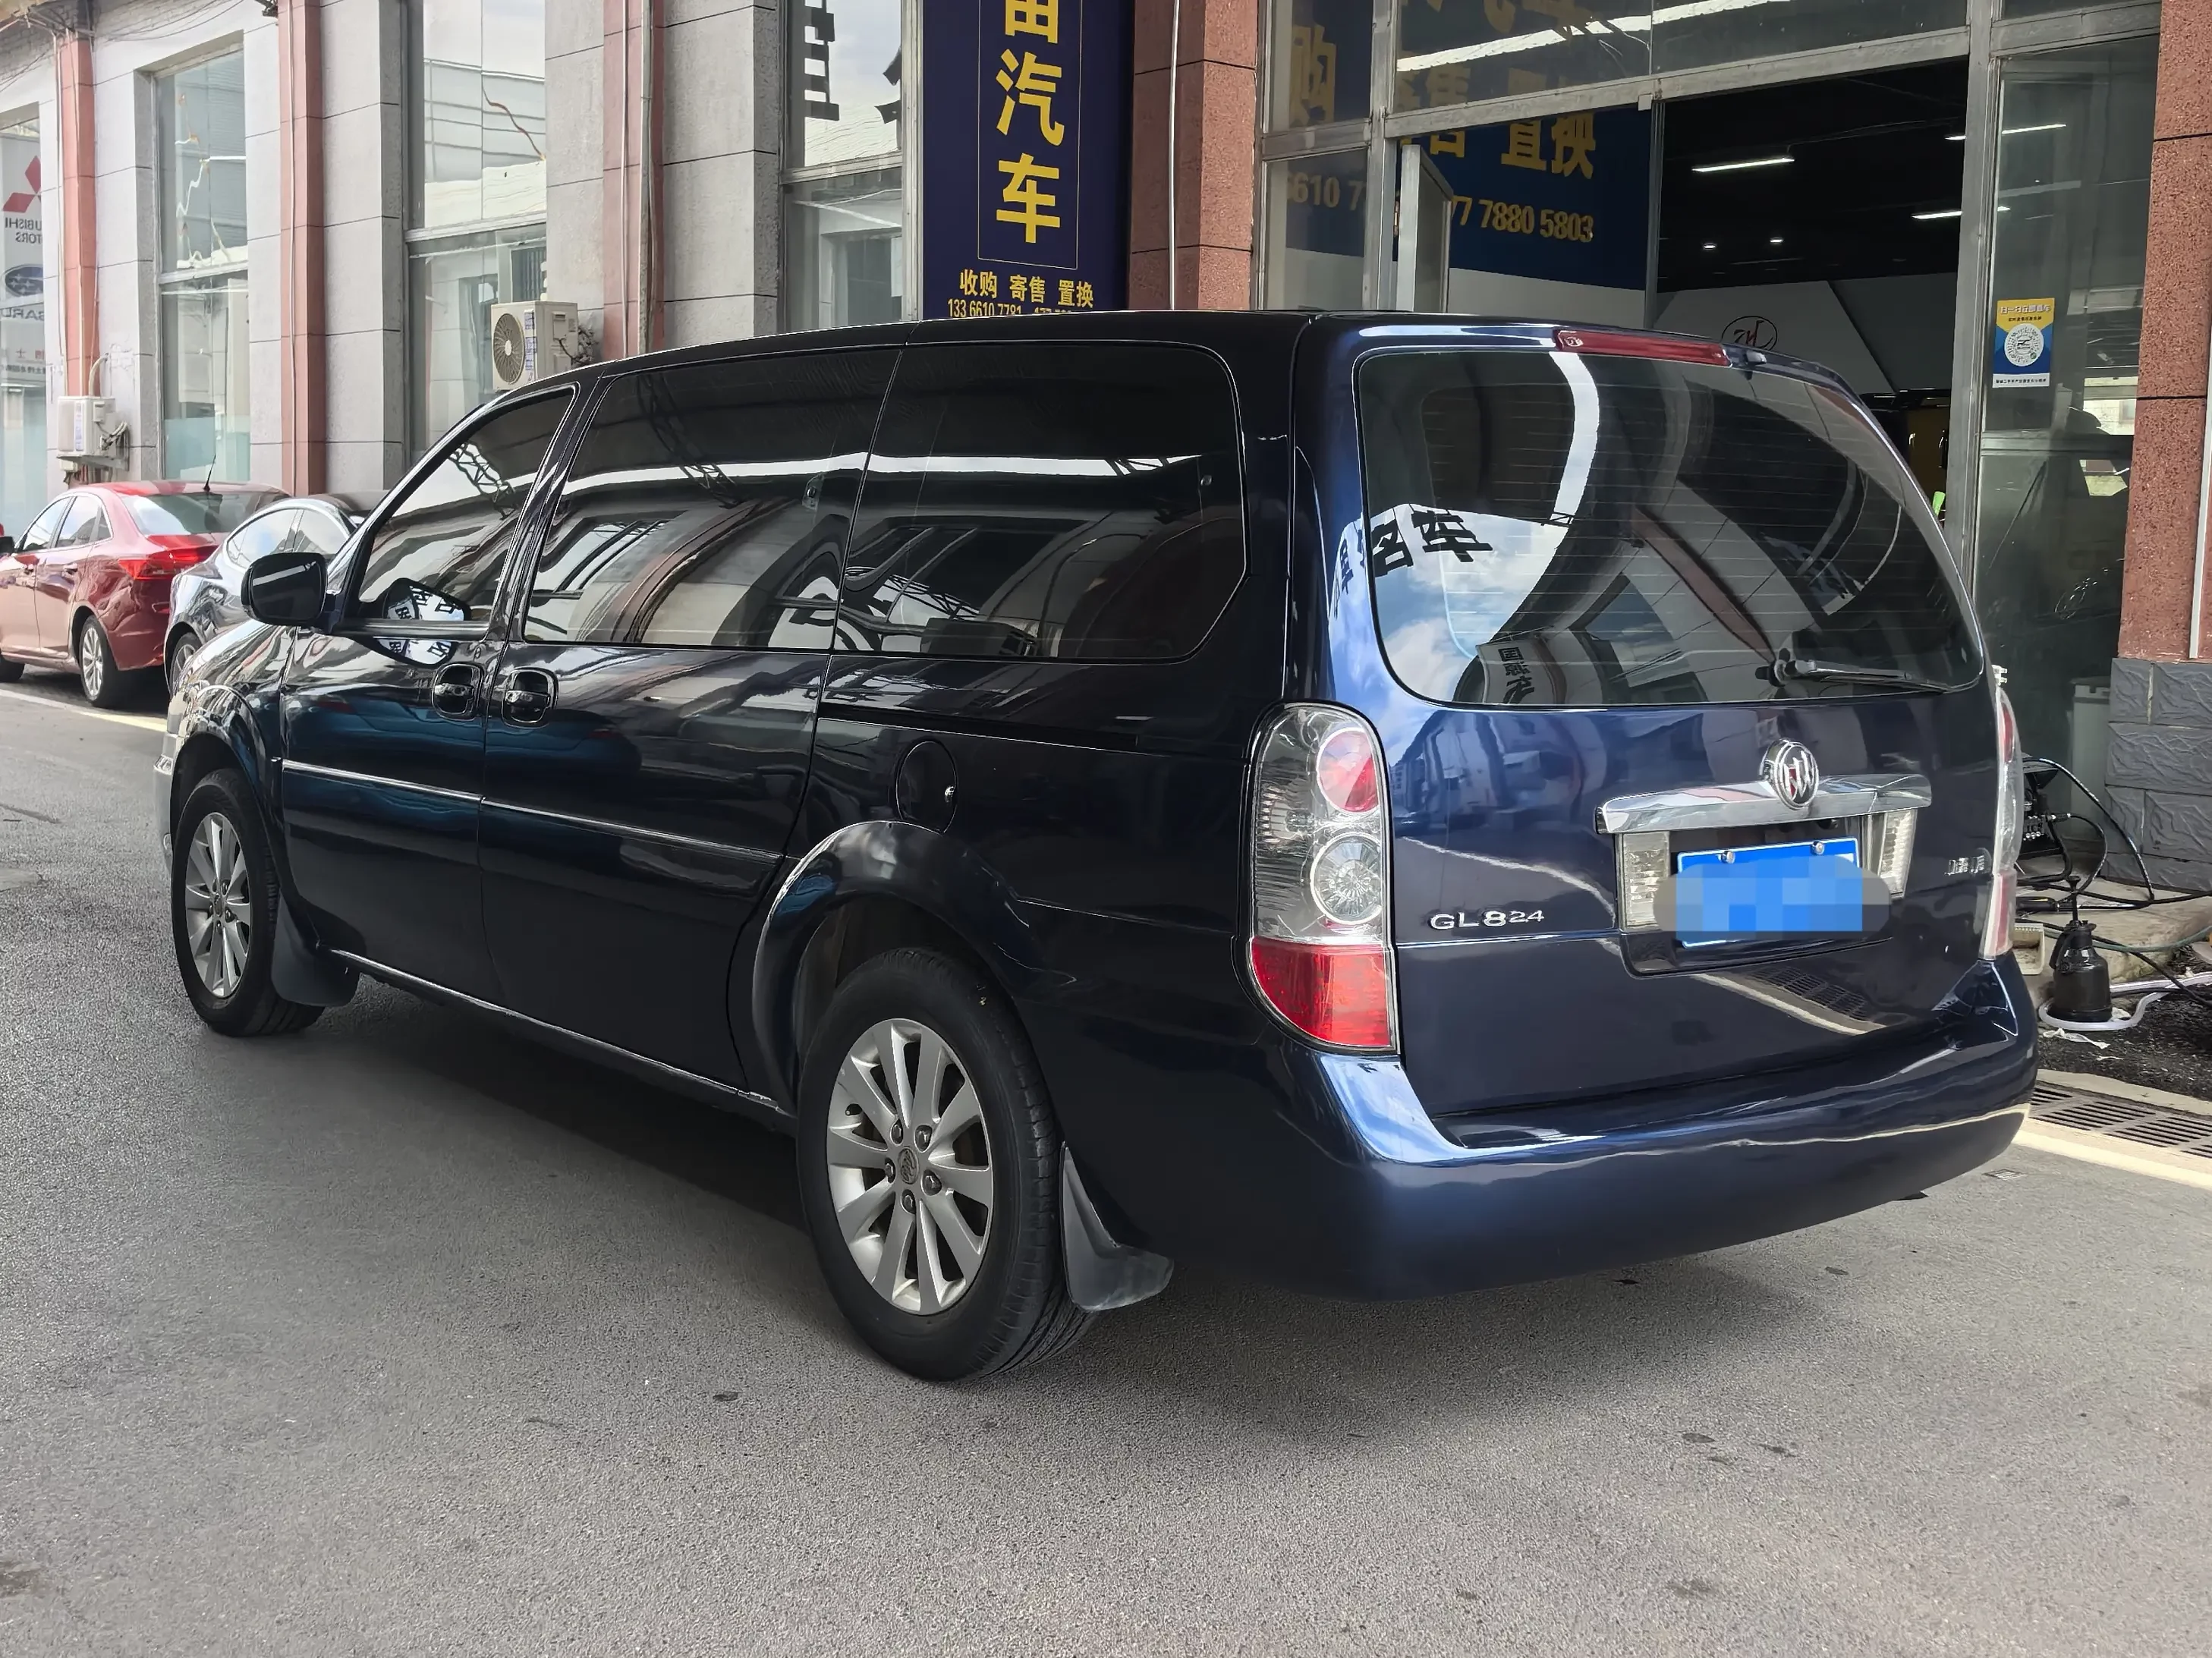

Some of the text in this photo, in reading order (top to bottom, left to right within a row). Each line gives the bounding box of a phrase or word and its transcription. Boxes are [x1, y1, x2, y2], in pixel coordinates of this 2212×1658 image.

[1478, 199, 1534, 234] 7880
[1540, 209, 1594, 244] 5803
[948, 298, 968, 319] 133
[969, 300, 995, 317] 6610
[959, 268, 1094, 309] 收购 寄售 置换
